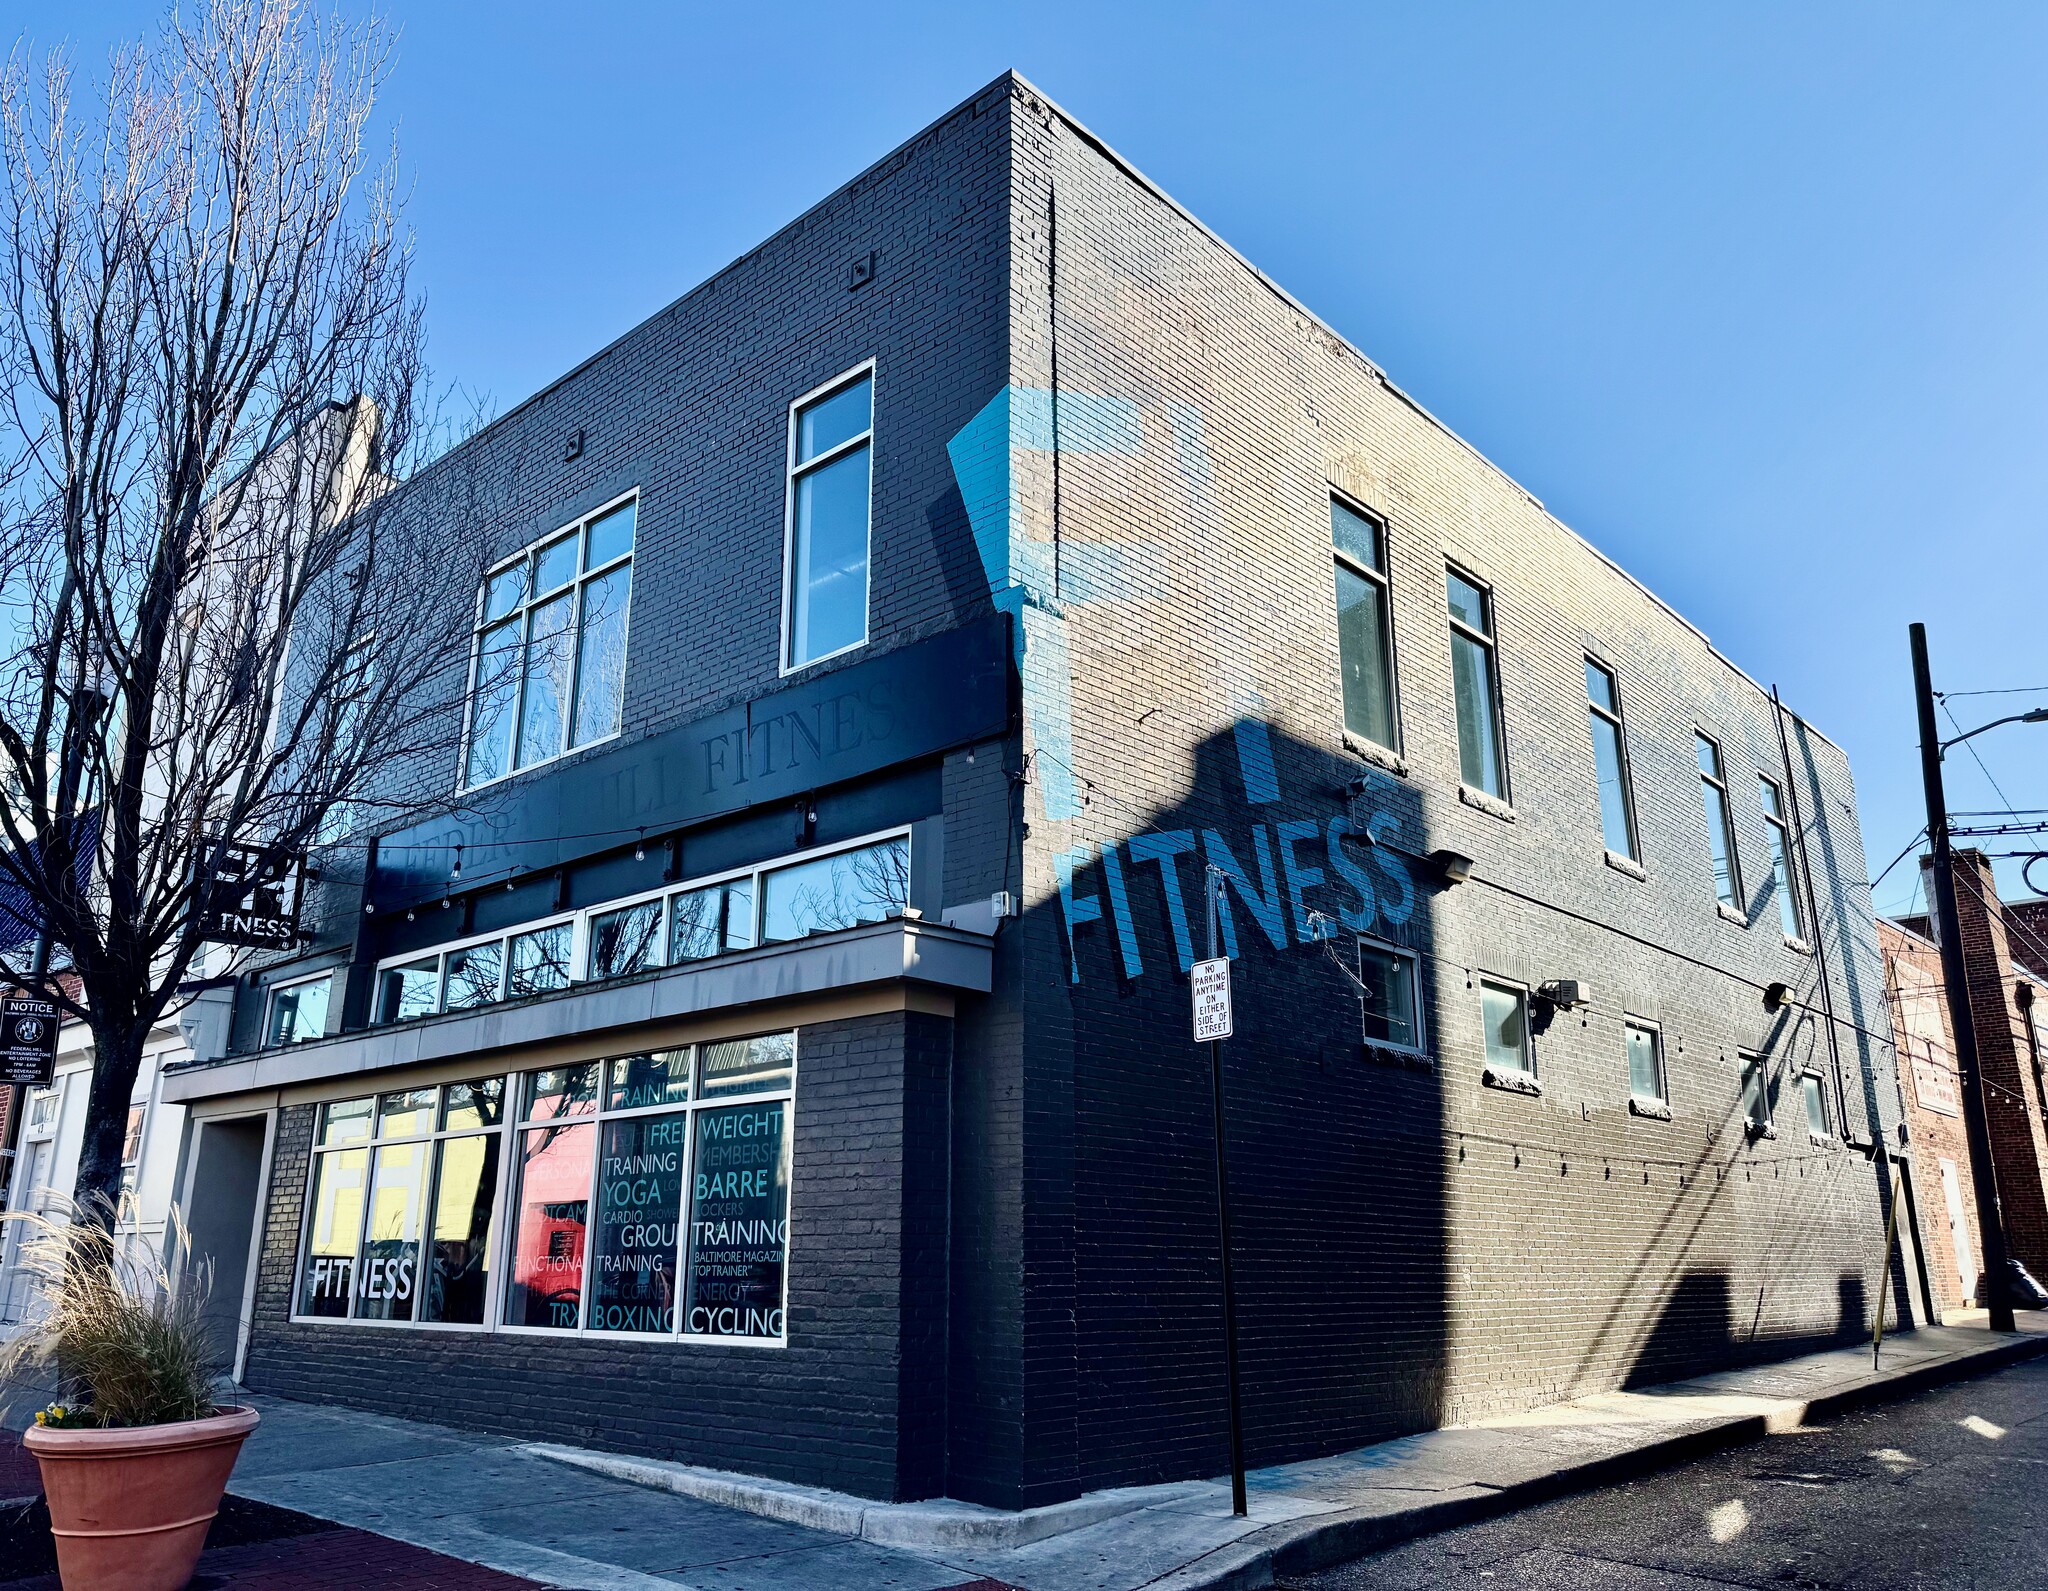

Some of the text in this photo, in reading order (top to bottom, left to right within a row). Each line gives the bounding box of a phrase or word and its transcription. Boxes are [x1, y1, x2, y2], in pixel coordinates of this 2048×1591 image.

[1052, 809, 1415, 984] FITNESS
[1204, 964, 1215, 974] NO
[1195, 971, 1226, 987] PARKING
[1196, 981, 1226, 996] ANYTIME
[10, 1002, 54, 1013] NOTICE
[1205, 994, 1216, 1005] ON
[1199, 1002, 1225, 1016] EITHER
[1197, 1011, 1228, 1026] SIDE OF
[1199, 1022, 1227, 1036] STREET
[604, 1152, 678, 1177] TRAINING
[604, 1178, 662, 1207] YOGA
[696, 1169, 769, 1200] BARRE
[603, 1209, 643, 1225] CARDIO
[596, 1254, 664, 1272] TRAINING
[694, 1250, 742, 1263] BALTIMORE
[311, 1258, 413, 1300] FITNESS
[689, 1306, 783, 1337] CYCLING
